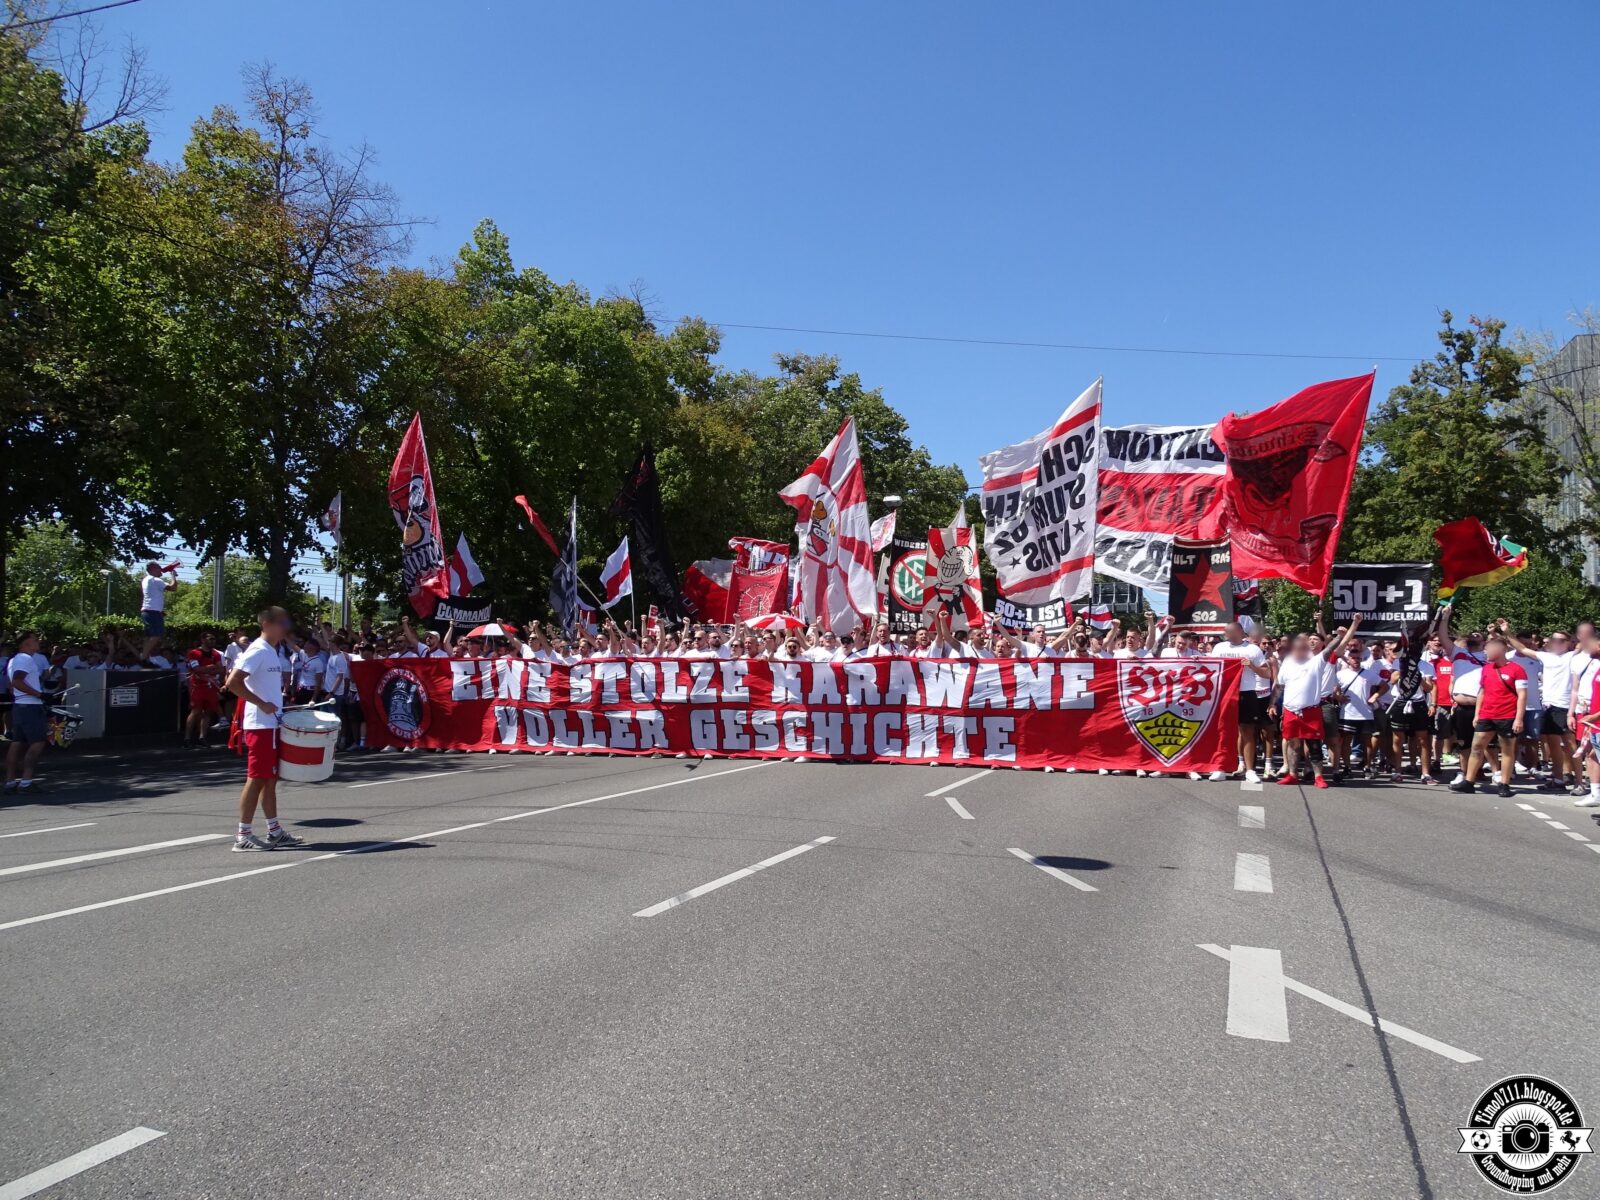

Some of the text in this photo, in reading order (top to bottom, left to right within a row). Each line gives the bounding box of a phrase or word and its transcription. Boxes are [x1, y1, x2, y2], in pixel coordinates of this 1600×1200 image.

[1173, 551, 1231, 566] ULT RAS
[1333, 579, 1428, 611] 50+1
[895, 610, 916, 623] FÜR
[994, 599, 1064, 622] 50+1 IST
[1333, 612, 1428, 621] UNVHANDELBAR
[450, 659, 1095, 711] EINE STOLZE KARAWANE
[1143, 708, 1195, 716] 18 93
[494, 705, 1017, 763] VOLLER GESCHICHTE
